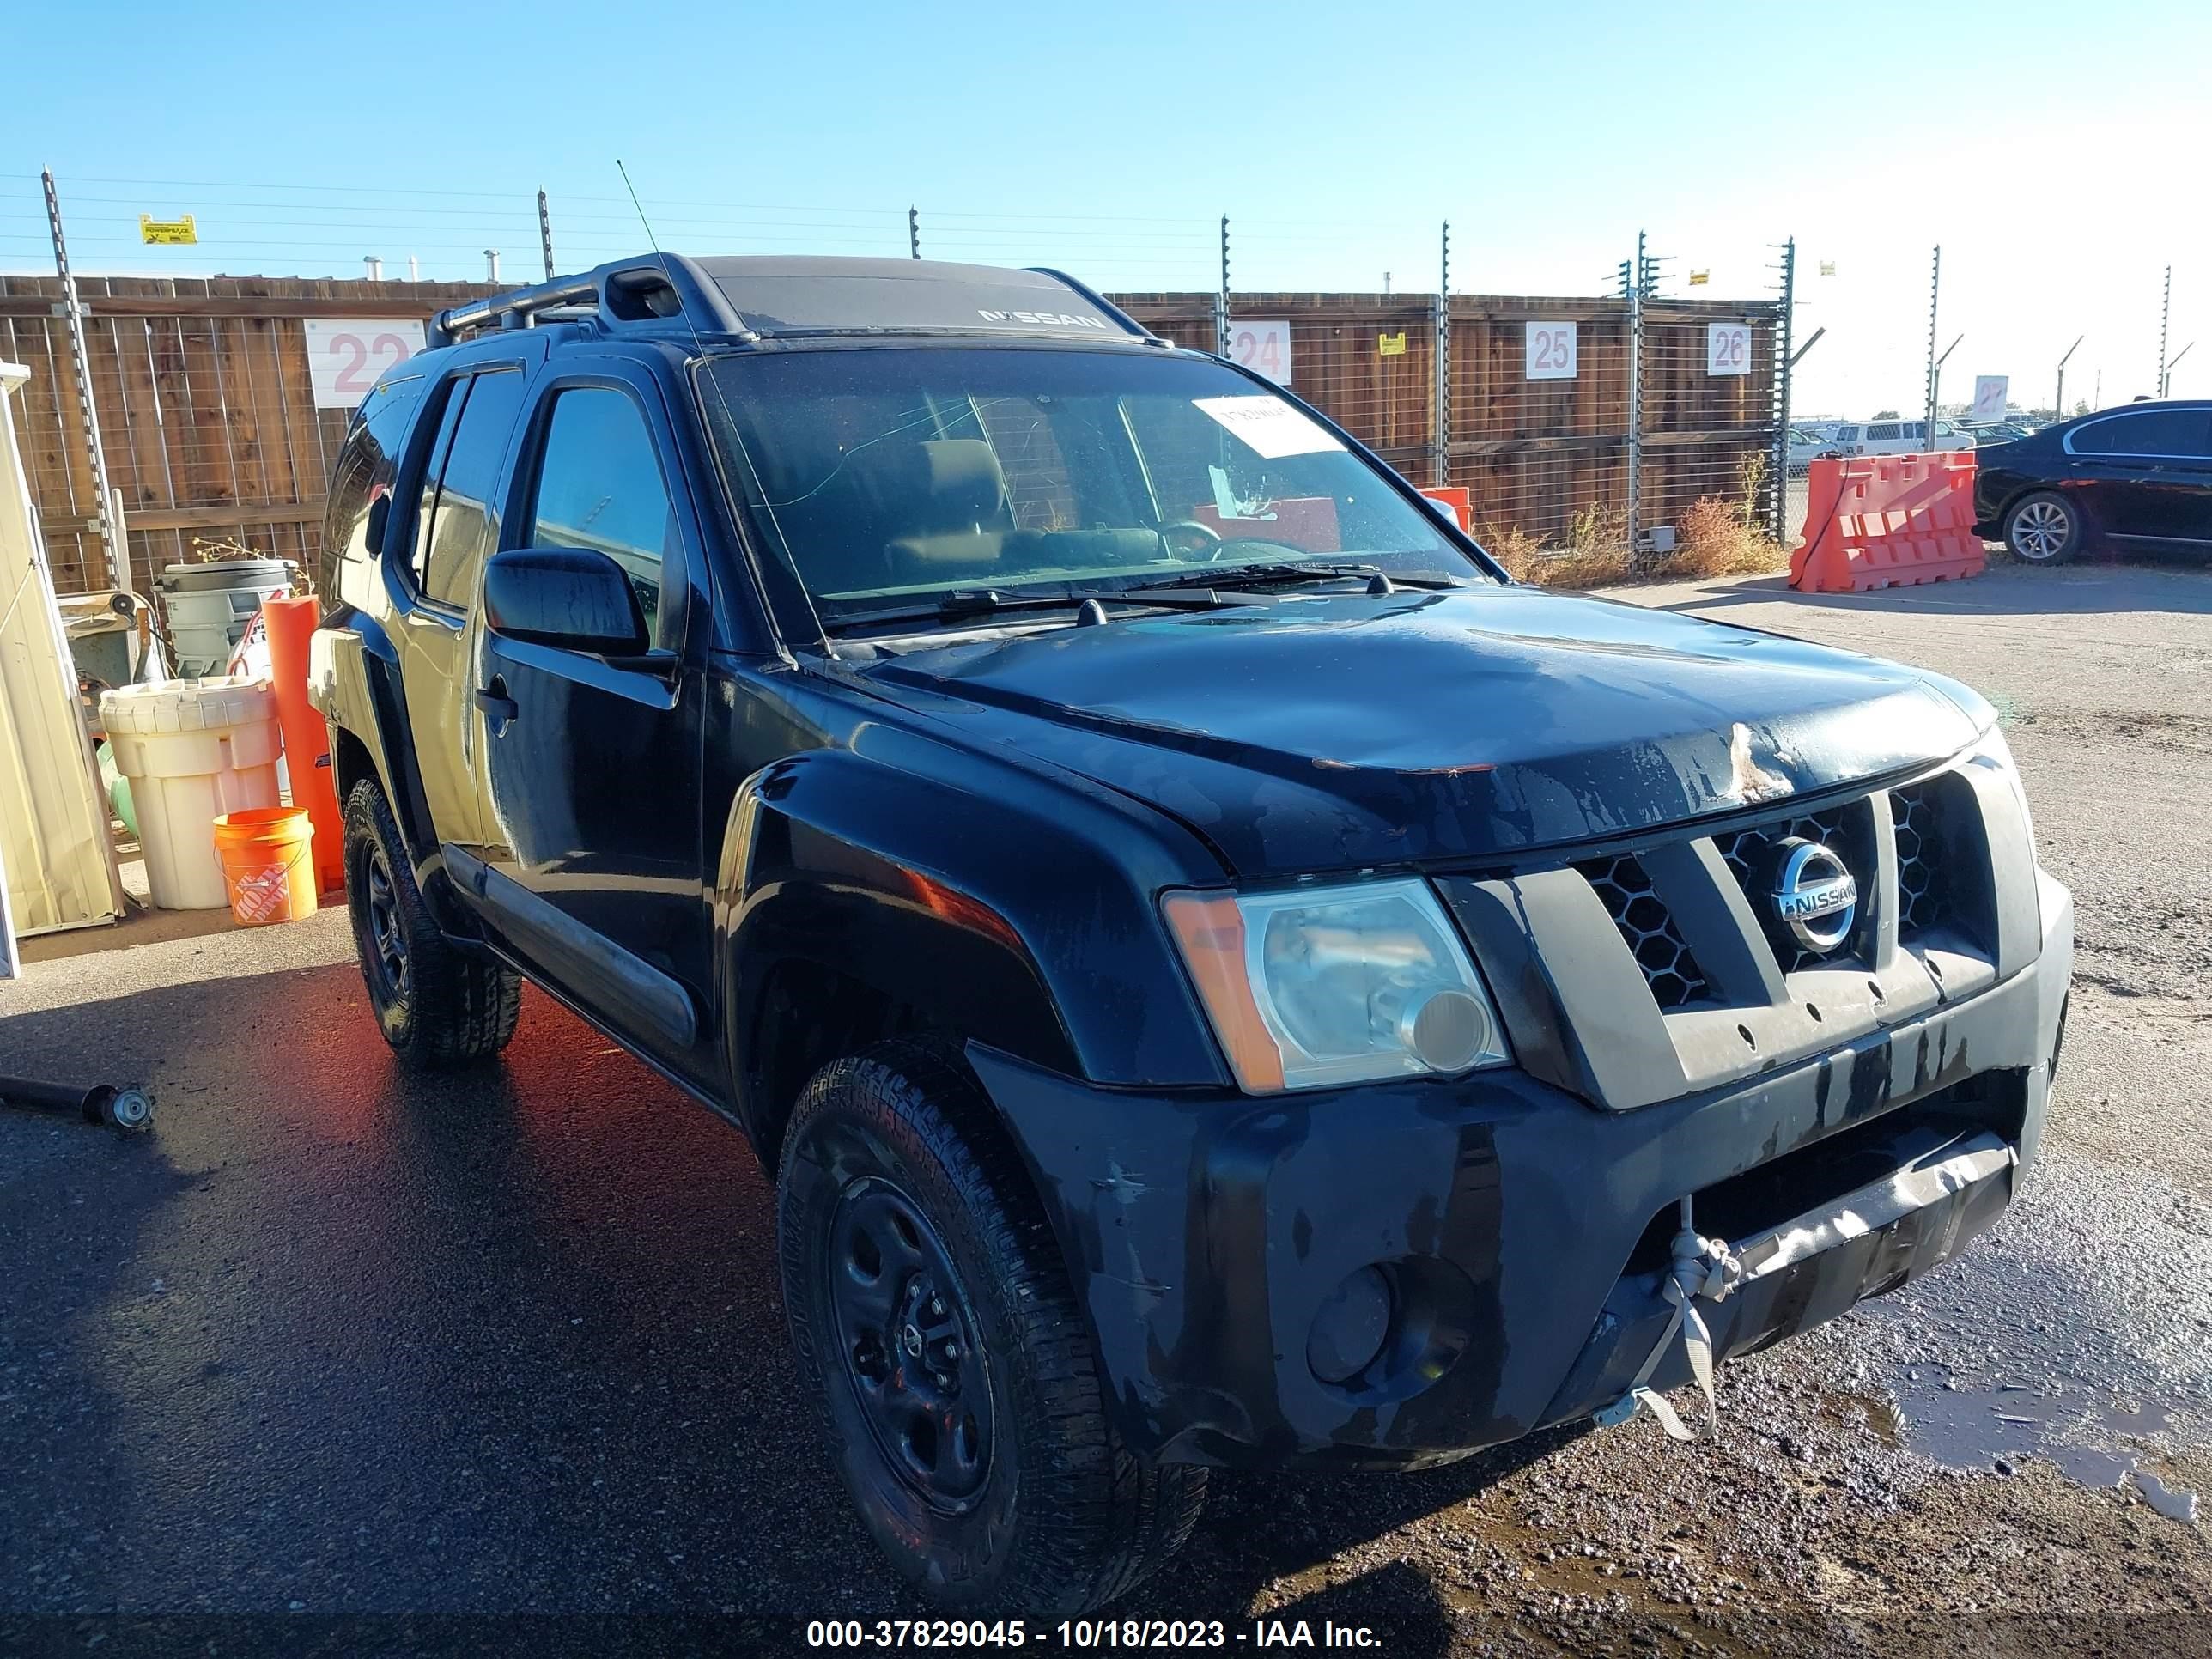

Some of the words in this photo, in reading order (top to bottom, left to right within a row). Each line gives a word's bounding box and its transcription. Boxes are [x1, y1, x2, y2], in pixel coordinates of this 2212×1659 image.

[978, 309, 1106, 329] NISSAN
[329, 332, 410, 392] 22
[1237, 331, 1281, 375] 24
[1535, 330, 1569, 369] 25
[1715, 331, 1745, 367] 26
[1980, 383, 2006, 414] 27
[235, 872, 257, 895] THE
[236, 864, 285, 921] HOME
[1796, 882, 1856, 914] NISSAN
[253, 884, 289, 922] DEPOT
